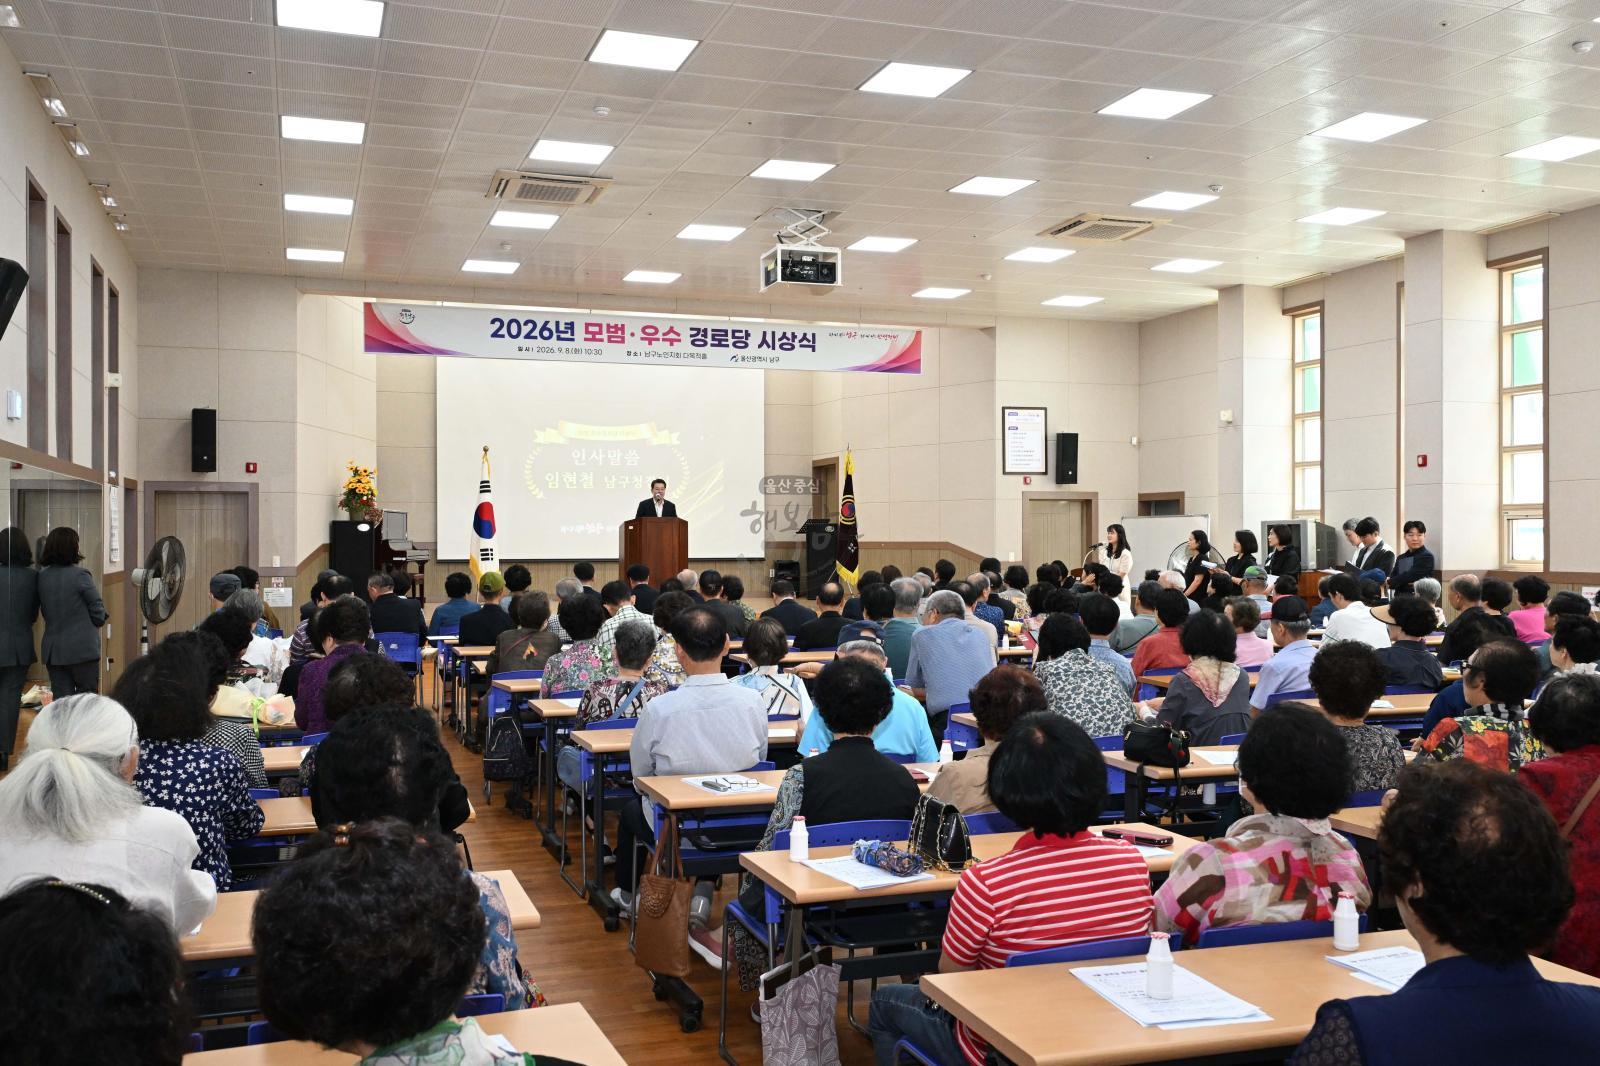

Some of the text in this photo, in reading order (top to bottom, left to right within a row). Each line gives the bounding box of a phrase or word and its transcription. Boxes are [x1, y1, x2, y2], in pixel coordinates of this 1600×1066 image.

[490, 317, 817, 352] 2026년 모범·우수 경로당 시상식
[584, 348, 603, 356] 10:30
[644, 350, 682, 359] 남구노인지회
[740, 355, 768, 363] 울산광역시
[571, 448, 641, 466] 인사말씀
[544, 471, 594, 489] 임현철
